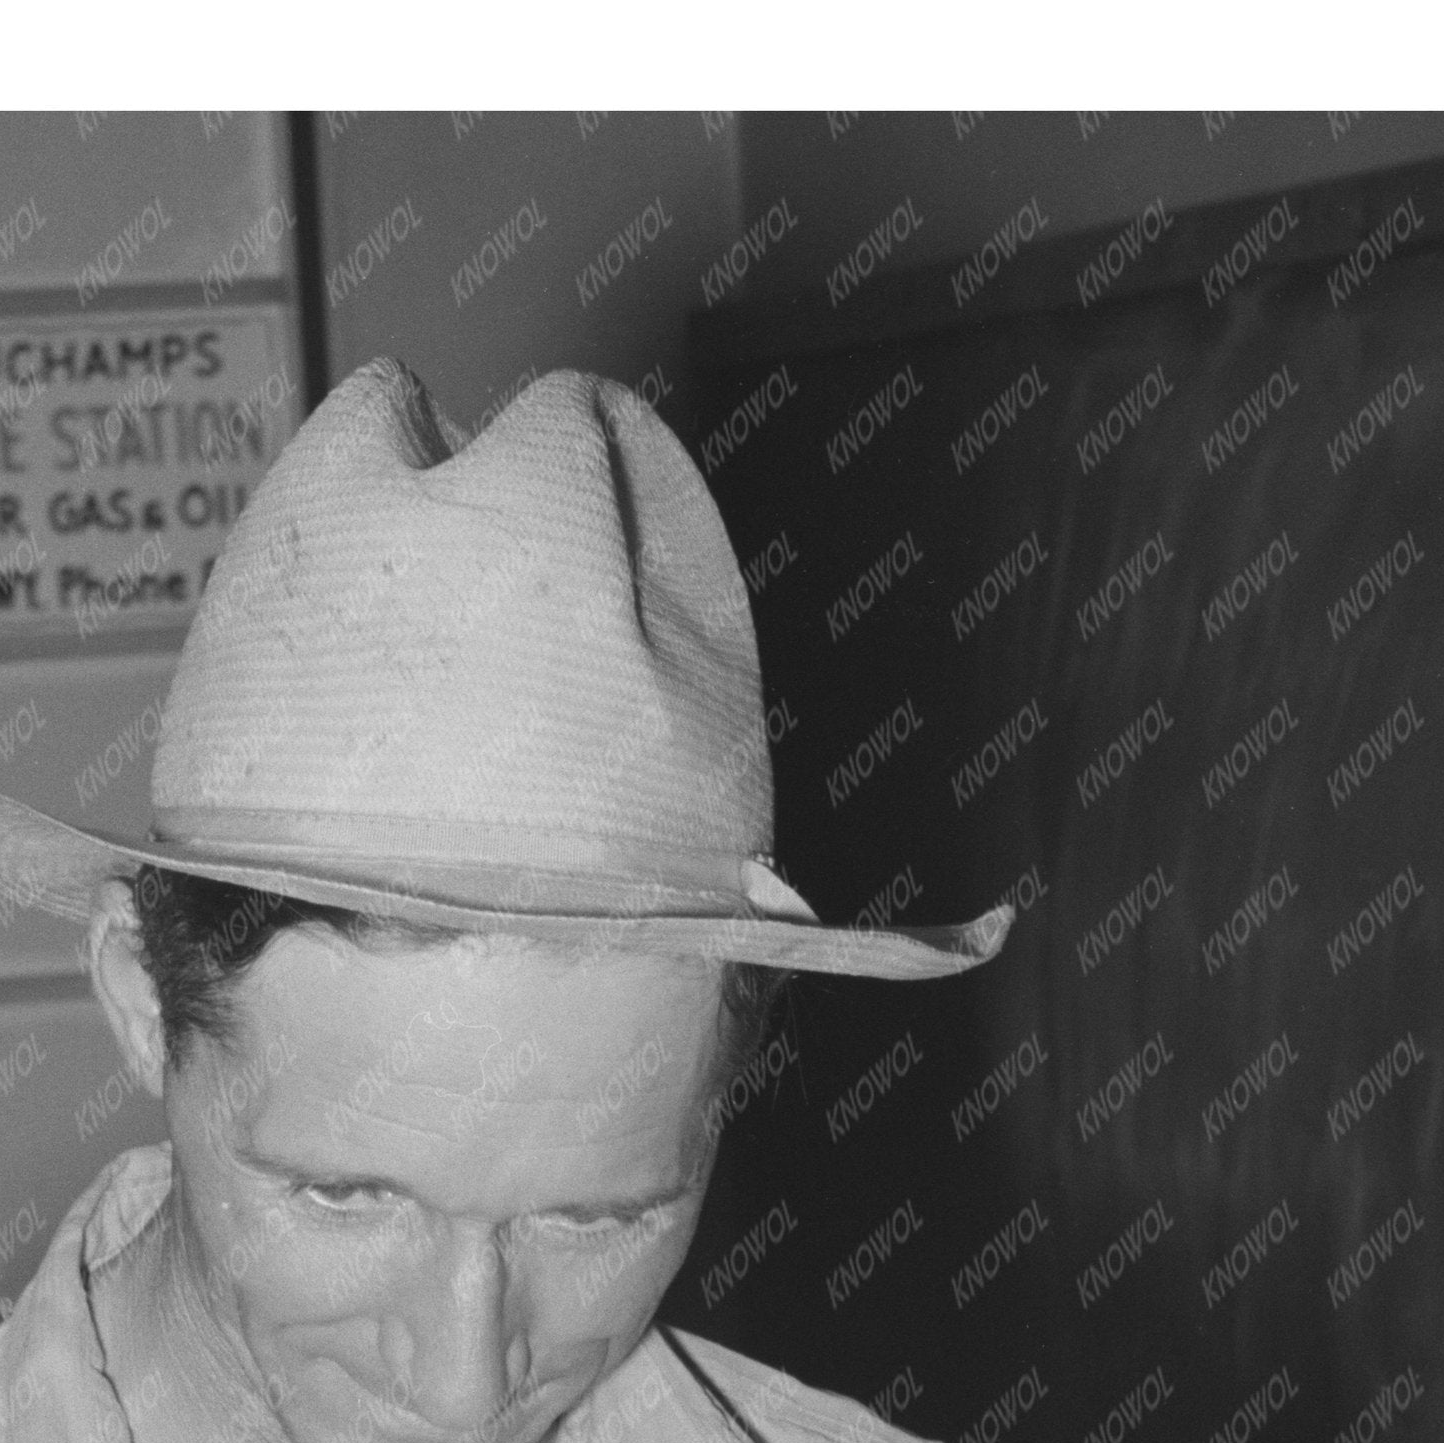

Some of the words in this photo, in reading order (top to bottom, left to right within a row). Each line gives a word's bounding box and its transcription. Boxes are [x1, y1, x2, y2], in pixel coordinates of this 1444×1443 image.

[51, 398, 265, 472] STATION
[47, 486, 135, 536] GAS
[58, 565, 188, 610] Phone
